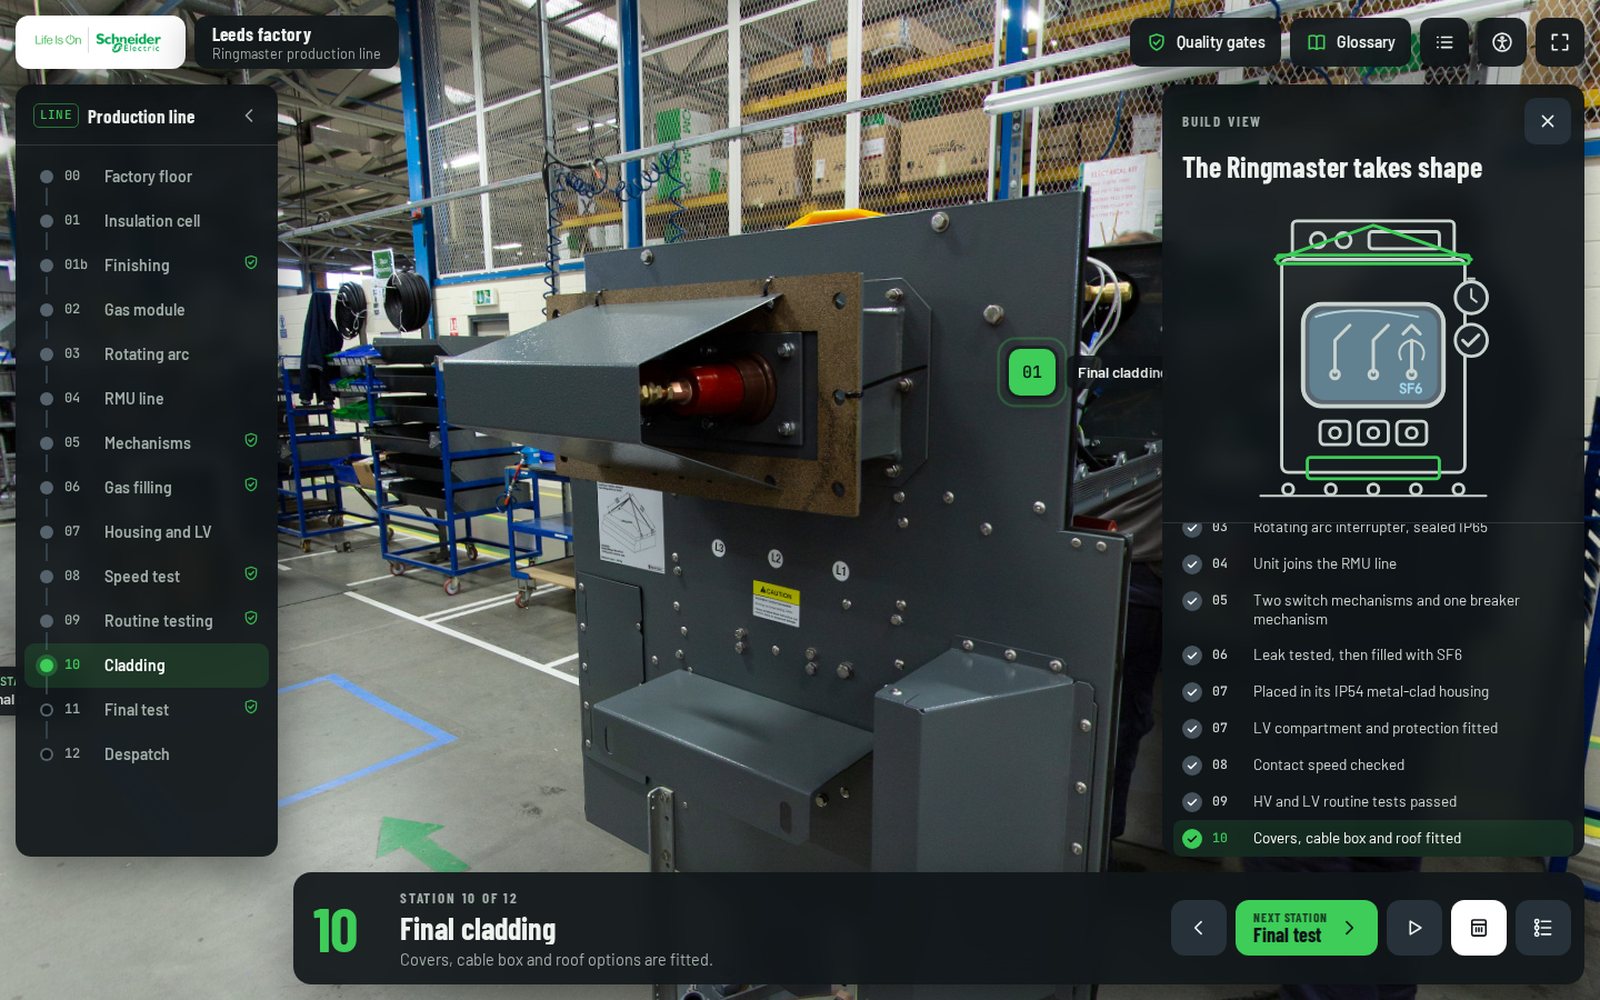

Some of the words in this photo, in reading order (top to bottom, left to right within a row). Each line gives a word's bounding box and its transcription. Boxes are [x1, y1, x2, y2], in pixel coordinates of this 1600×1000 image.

[714, 541, 724, 553] L3
[771, 552, 782, 564] L2
[835, 564, 846, 576] L1
[766, 588, 792, 600] CAUTION
